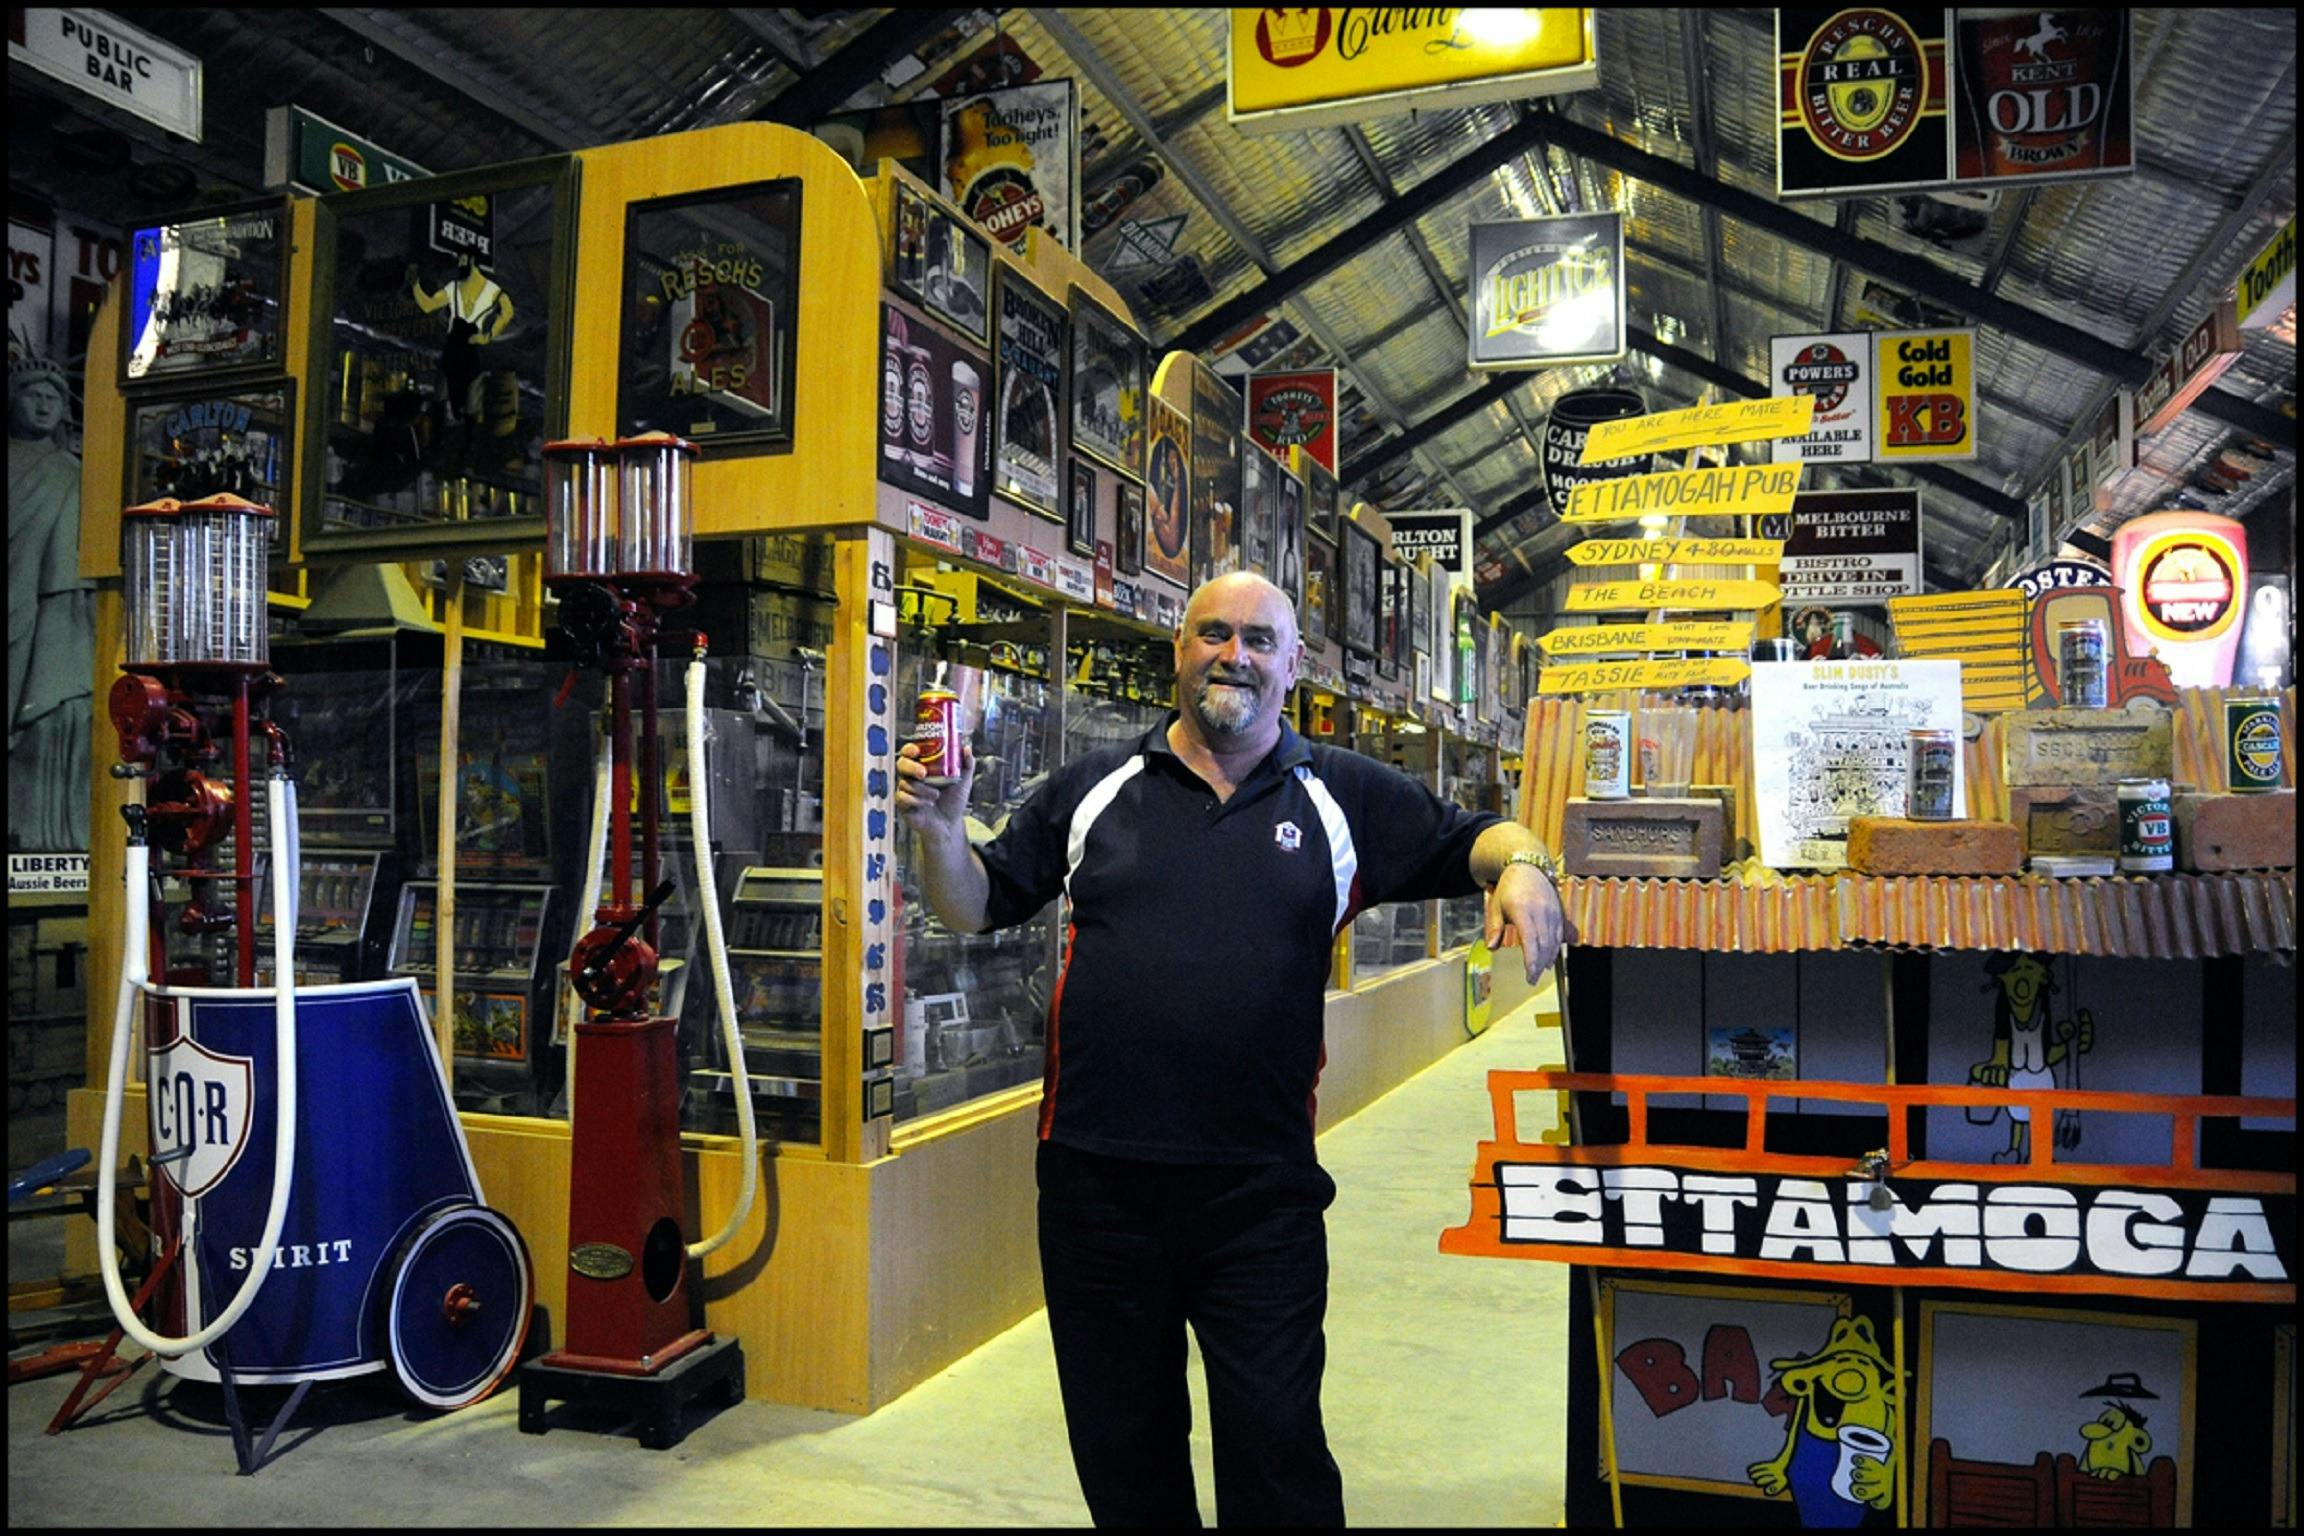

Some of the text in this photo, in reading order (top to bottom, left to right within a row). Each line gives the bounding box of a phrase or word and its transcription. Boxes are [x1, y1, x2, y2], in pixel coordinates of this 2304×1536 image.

[62, 15, 154, 80] PUBLIC
[85, 53, 135, 94] BAR
[1824, 60, 1904, 81] REAL
[2012, 62, 2077, 82] KENT
[1811, 84, 1914, 149] BITTER BEER
[1988, 82, 2101, 135] OLD
[2010, 138, 2079, 163] BROWN
[337, 157, 359, 180] VB
[1898, 340, 1950, 363] Cold
[669, 363, 747, 400] ALES
[1788, 364, 1854, 381] POWERS
[1898, 365, 1953, 387] Gold
[167, 401, 252, 438] CARLTON
[1602, 423, 1627, 438] YOU
[1639, 416, 1665, 430] ARE
[1680, 407, 1723, 423] HERE
[1886, 393, 1967, 448] KB
[1801, 445, 1843, 458] HERE
[1570, 470, 1738, 517] ETTAMOGAH
[1741, 469, 1796, 501] PUB
[1796, 509, 1912, 526] MELBOURNE
[1815, 523, 1887, 539] BITTER
[1581, 540, 1679, 562] SYDNEY
[1796, 556, 1873, 569] BISTRO
[1583, 582, 1717, 602] THE BEACH
[1852, 584, 1911, 595] SHOP
[2160, 601, 2220, 623] NEW
[1551, 630, 1647, 652] BRISBANE
[1560, 665, 1645, 688] TASSIE
[1811, 663, 1900, 680] SLIM DUSTY'S
[1820, 682, 1848, 691] Drinking
[1850, 683, 1868, 691] Songs
[1880, 682, 1909, 690] Australia
[2144, 822, 2167, 835] VB
[12, 857, 90, 872] LIBERTY
[8, 876, 87, 890] Aussie Beers
[229, 1239, 353, 1270] SIRIT
